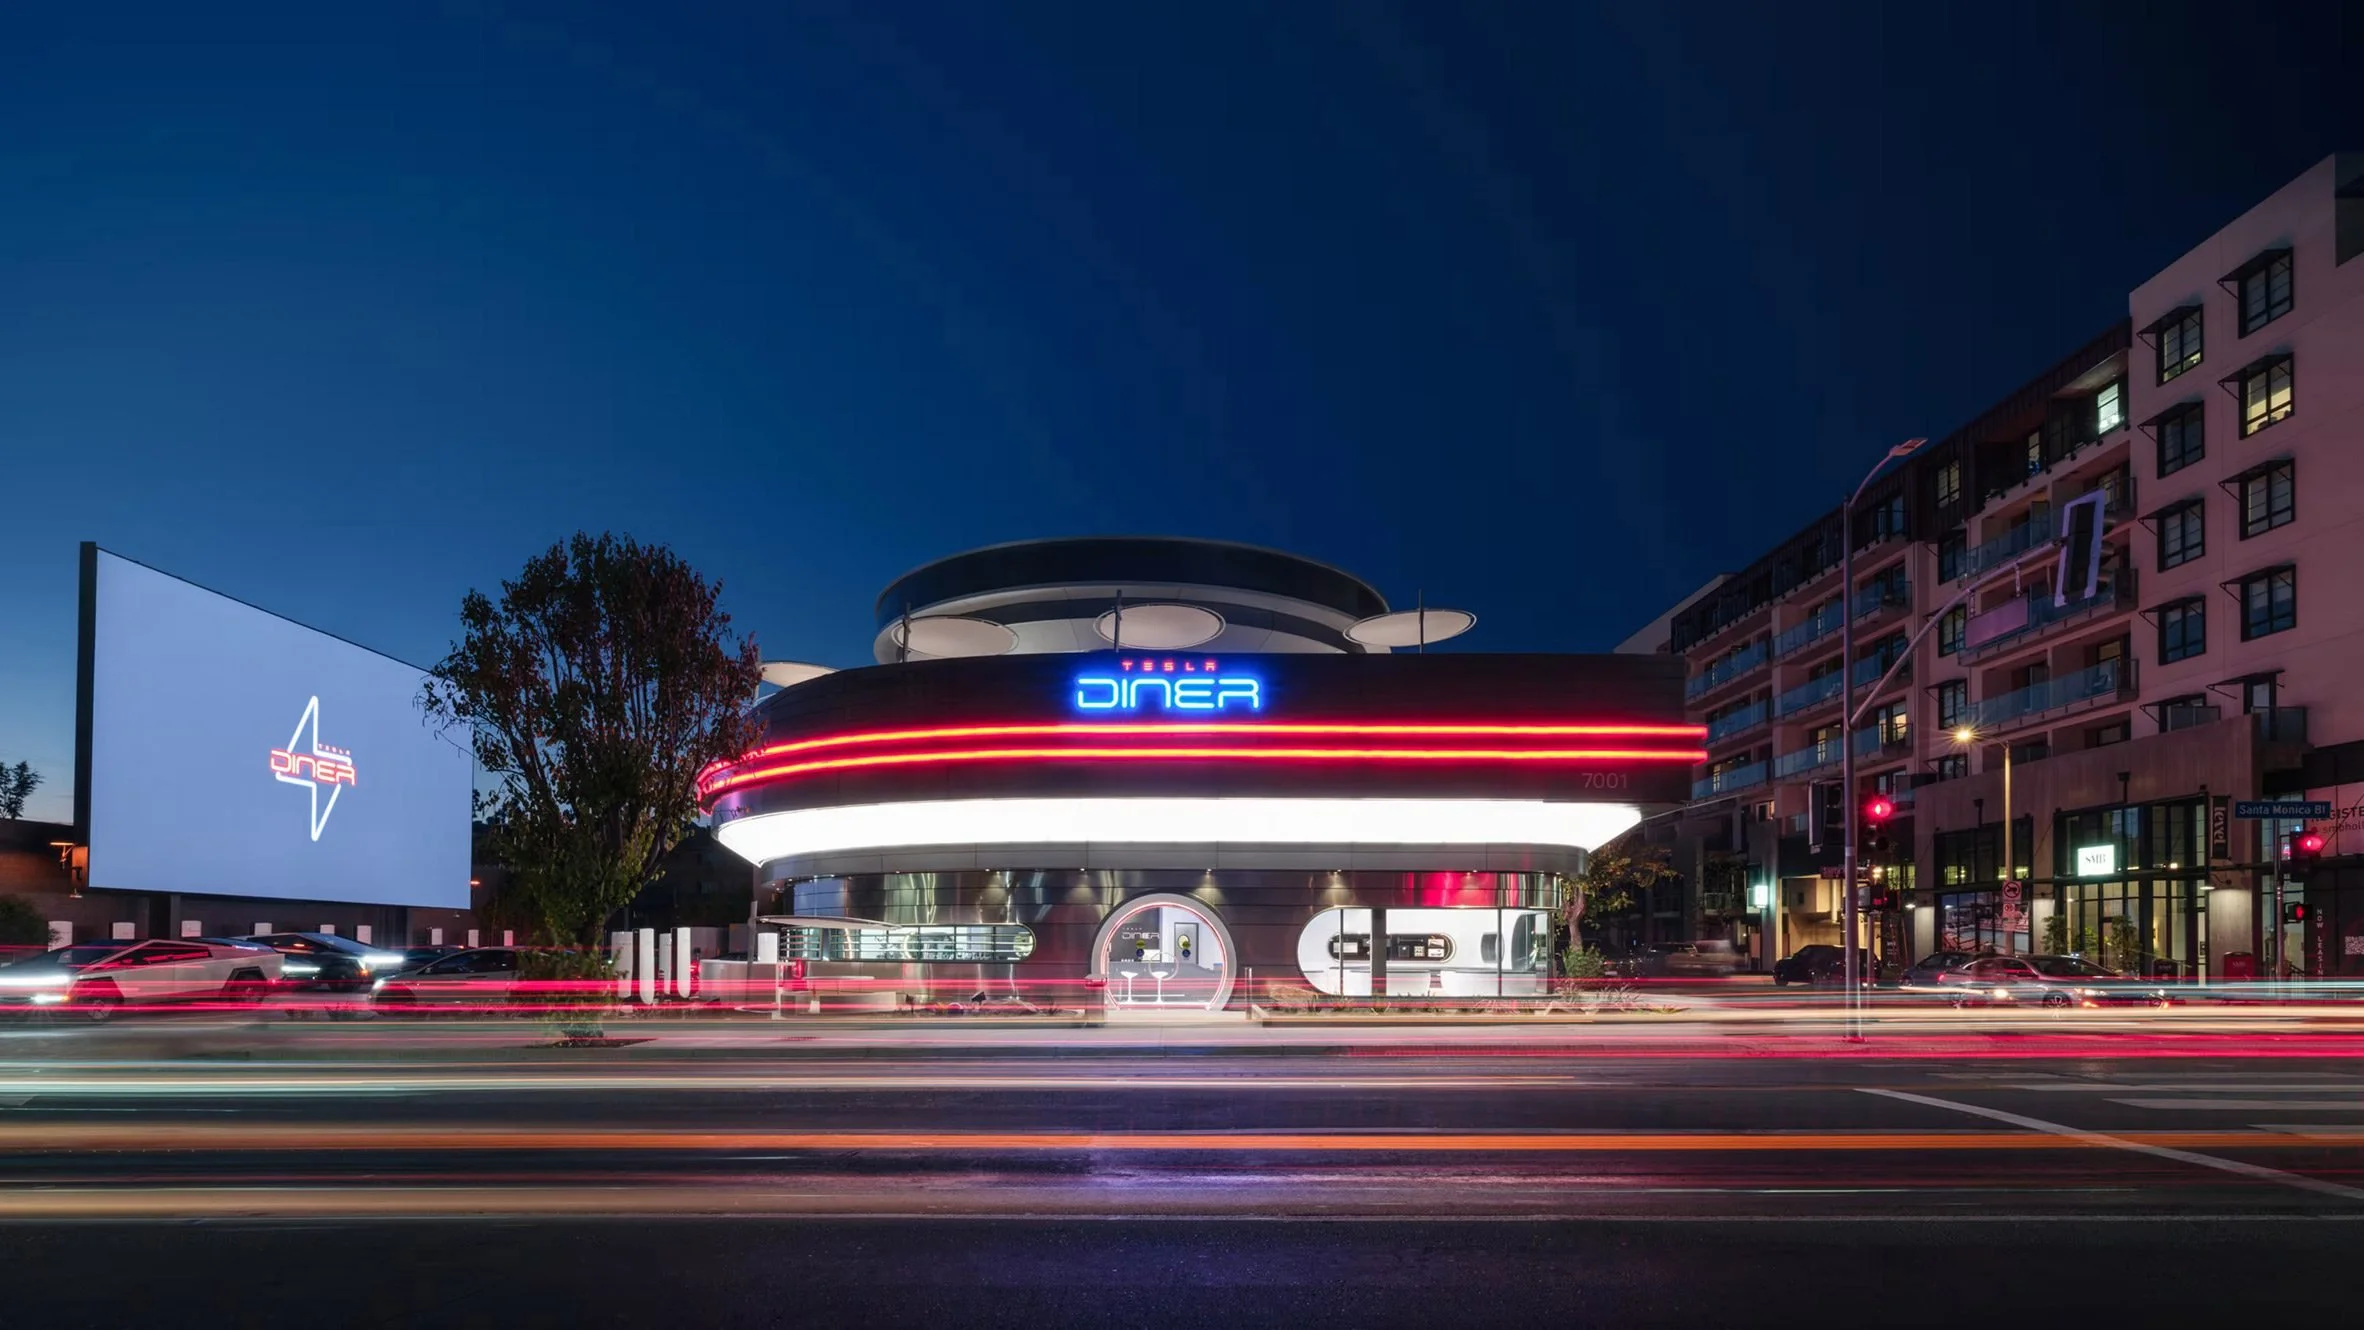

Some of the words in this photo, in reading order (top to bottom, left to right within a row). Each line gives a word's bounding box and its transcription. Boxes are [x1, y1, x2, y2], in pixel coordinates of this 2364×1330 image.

[1121, 661, 1216, 672] TESLA
[1077, 678, 1260, 709] DINER
[270, 749, 356, 786] DINER
[1581, 772, 1627, 789] 7001
[2239, 804, 2269, 815] Santa
[2273, 804, 2311, 815] Monica
[2213, 806, 2226, 845] level
[2084, 853, 2107, 865] SMB
[2316, 908, 2324, 928] NOW
